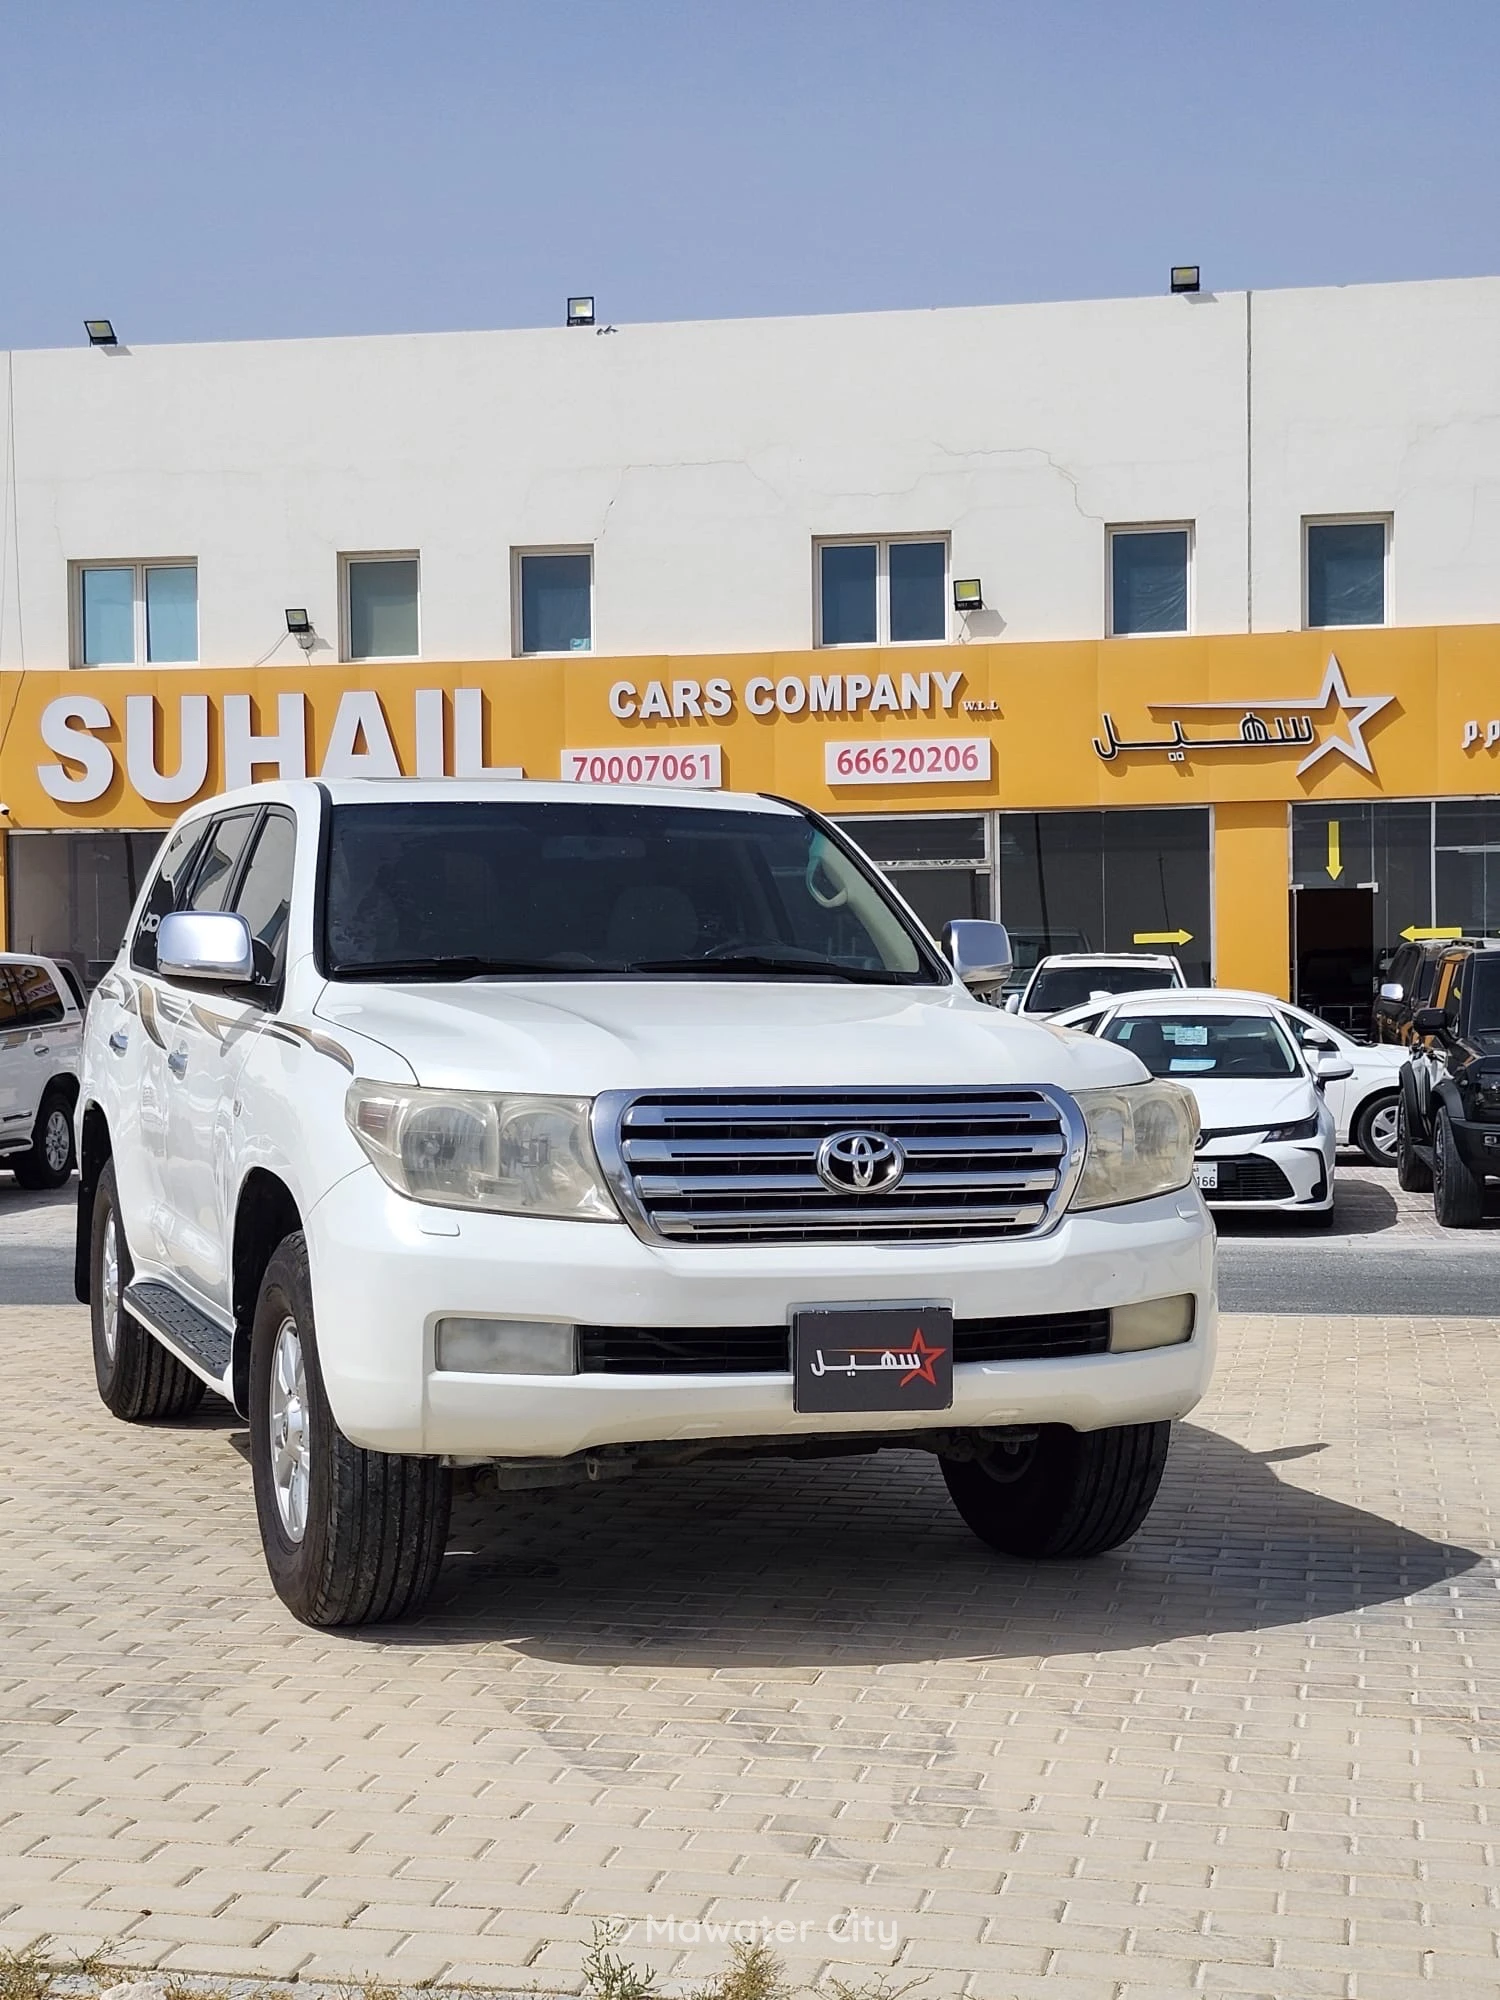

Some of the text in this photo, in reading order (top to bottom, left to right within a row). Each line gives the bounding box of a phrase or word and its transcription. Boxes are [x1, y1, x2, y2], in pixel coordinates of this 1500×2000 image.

[608, 677, 734, 719] CARS
[744, 671, 963, 716] COMPANY
[36, 687, 524, 804] SUHAIL
[1092, 711, 1314, 762] سهيل
[572, 754, 711, 784] 70007061
[836, 744, 980, 776] 66620206
[810, 1349, 921, 1377] سهيل
